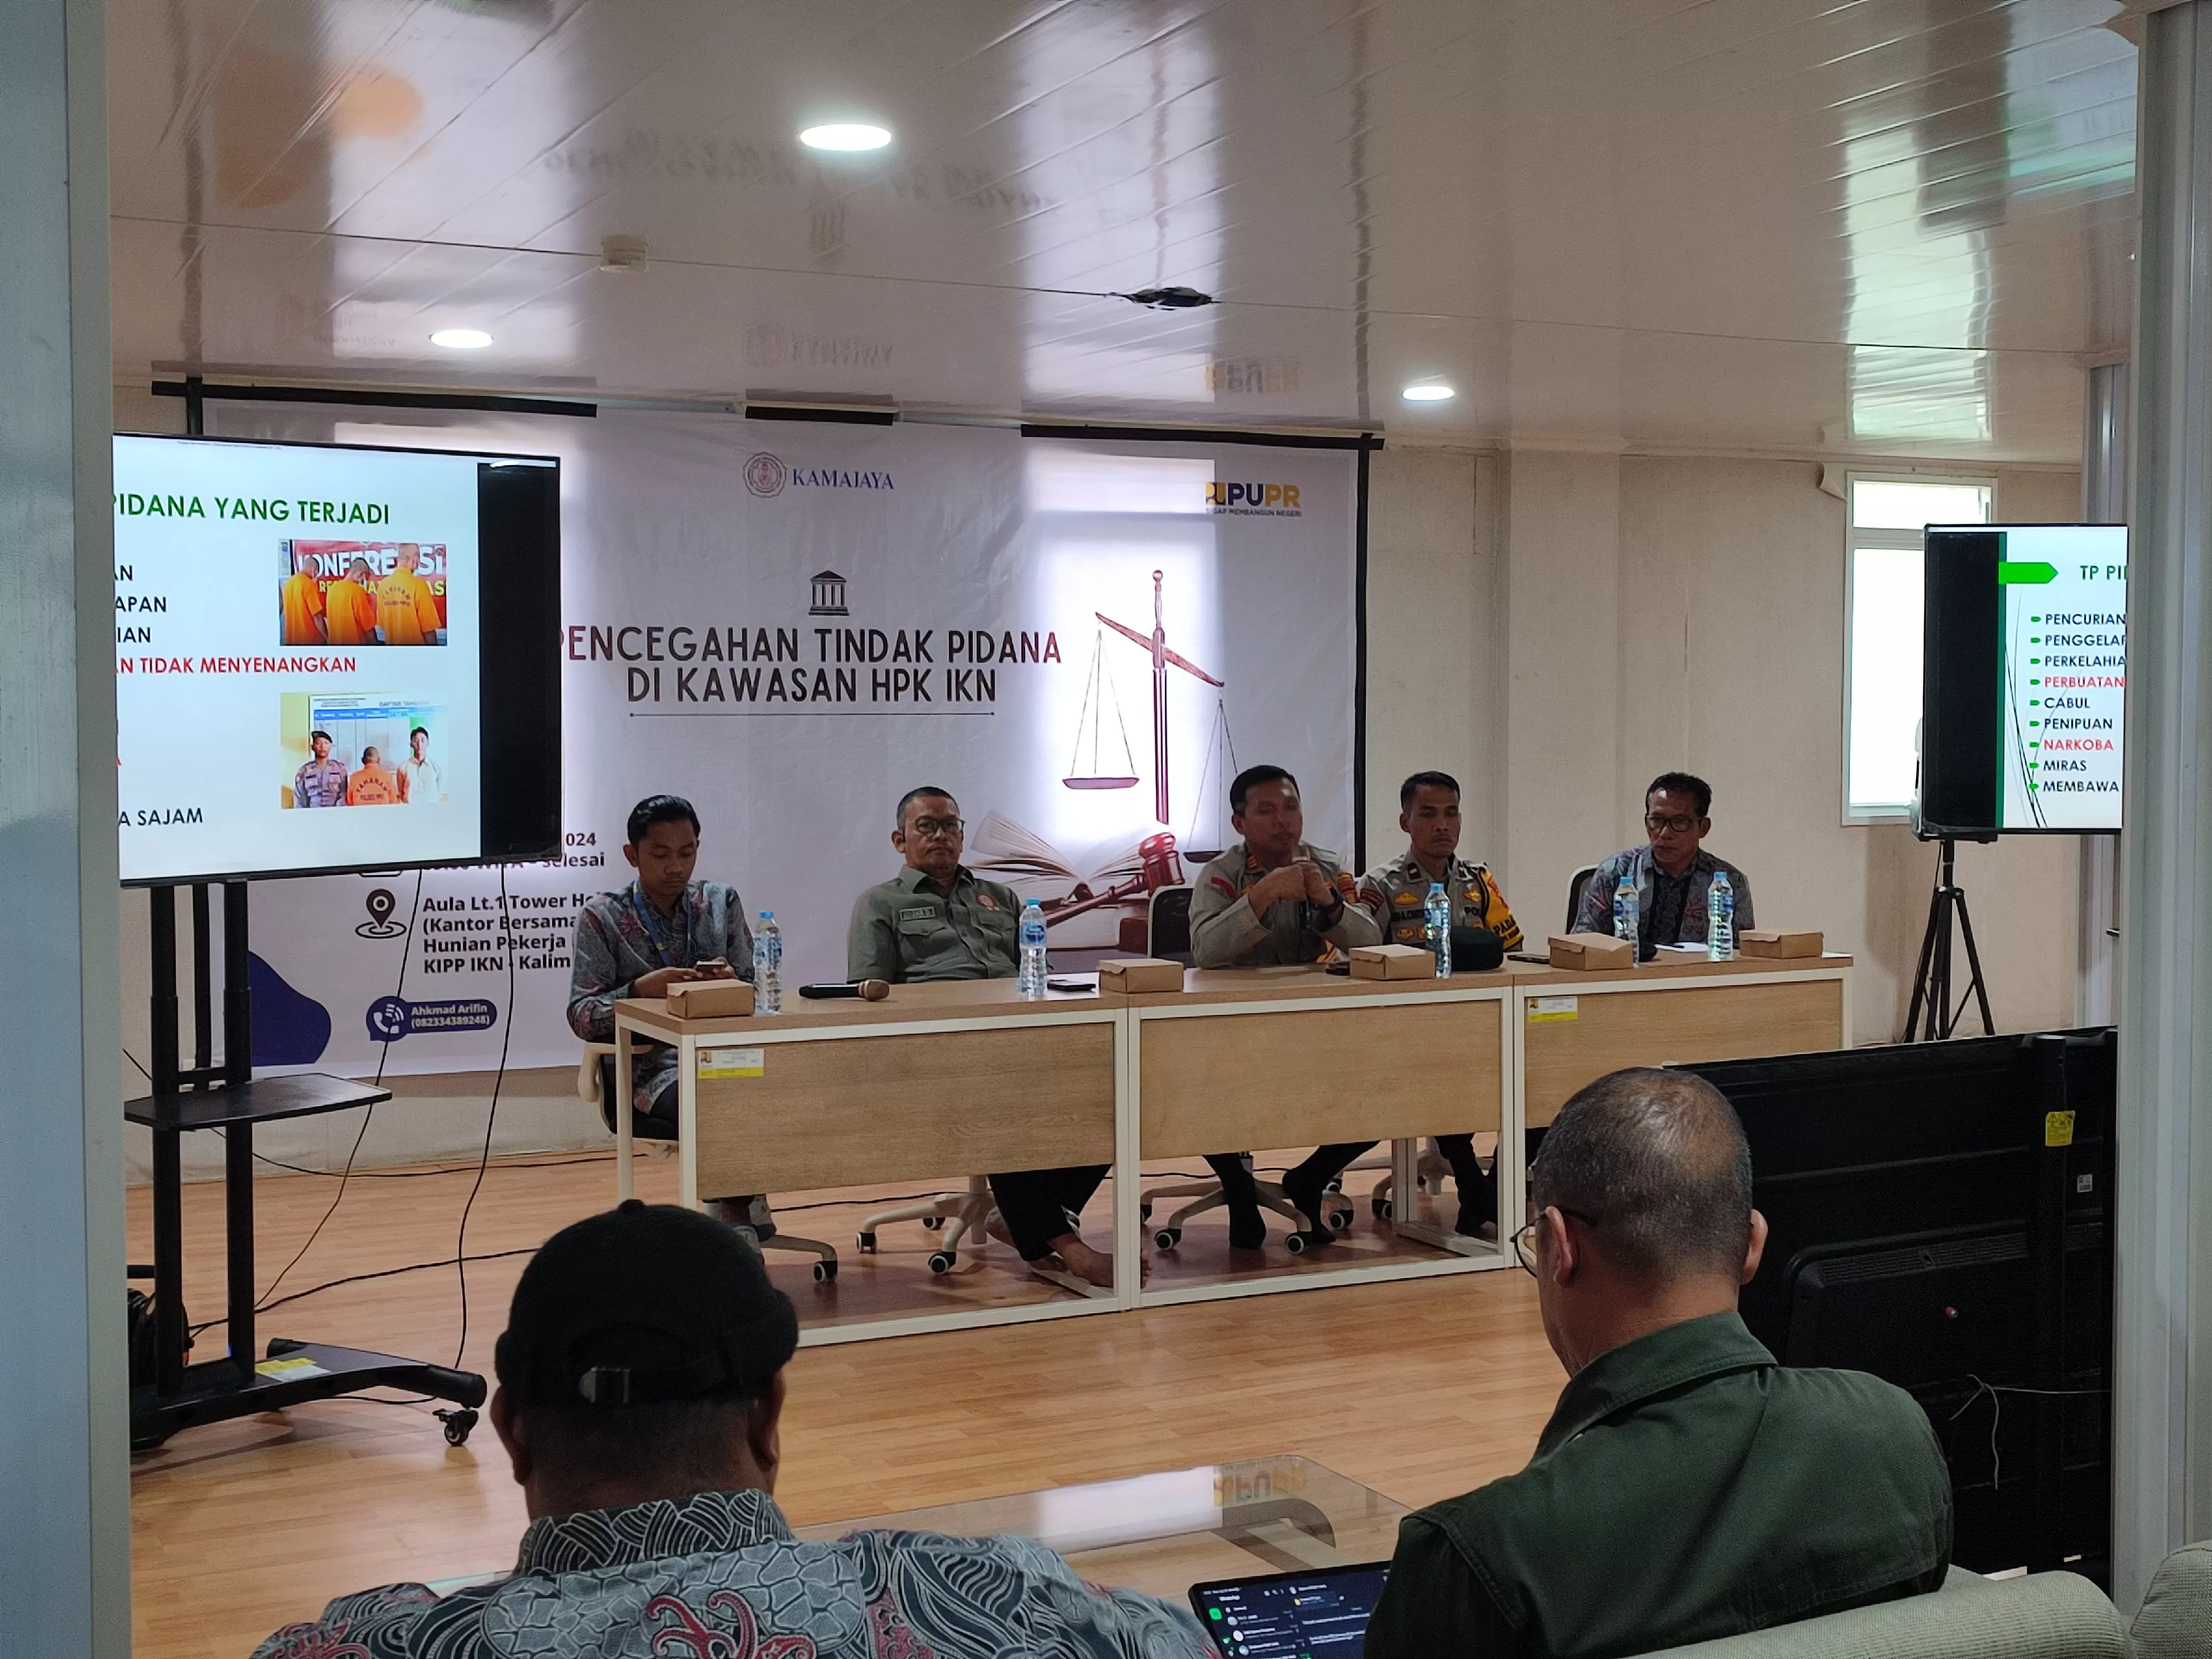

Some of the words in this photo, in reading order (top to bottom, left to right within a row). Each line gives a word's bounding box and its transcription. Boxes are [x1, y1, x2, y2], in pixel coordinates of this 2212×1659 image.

[1228, 483, 1301, 509] PUPR
[214, 497, 289, 521] YANG
[298, 500, 390, 524] TERJADI
[2080, 565, 2099, 580] TP
[2045, 613, 2126, 625] PENCURIAN
[117, 627, 150, 643] IAN
[561, 625, 798, 662] ENCEGAHAN
[814, 628, 933, 663] TINDAK
[948, 630, 1061, 664] PIDANA
[140, 658, 194, 674] TIDAK
[200, 656, 356, 673] MENYENANGKAN
[628, 667, 660, 702] DI
[677, 667, 856, 702] KAWASAN
[872, 668, 932, 702] HPK
[946, 668, 995, 702] IKN
[2045, 676, 2126, 687] PERBUATAN
[2044, 697, 2090, 708] CABUL
[2044, 718, 2112, 729] PENIPUAN
[2043, 739, 2114, 750] NARKOBA
[2043, 760, 2087, 771] MIRAS
[2043, 781, 2119, 792] MEMBAWA
[137, 808, 203, 826] SAJAM
[566, 833, 597, 846] 024
[423, 896, 466, 912] Aula
[509, 894, 567, 909] Tower
[424, 917, 494, 935] (Kantor
[424, 936, 491, 953] Hunian
[497, 933, 566, 952] Pekerja
[424, 959, 466, 973] KIPP
[471, 957, 503, 972] IKN
[519, 954, 571, 969] Kalim
[411, 1004, 456, 1015] Ahkmad
[458, 1003, 488, 1014] Arifin
